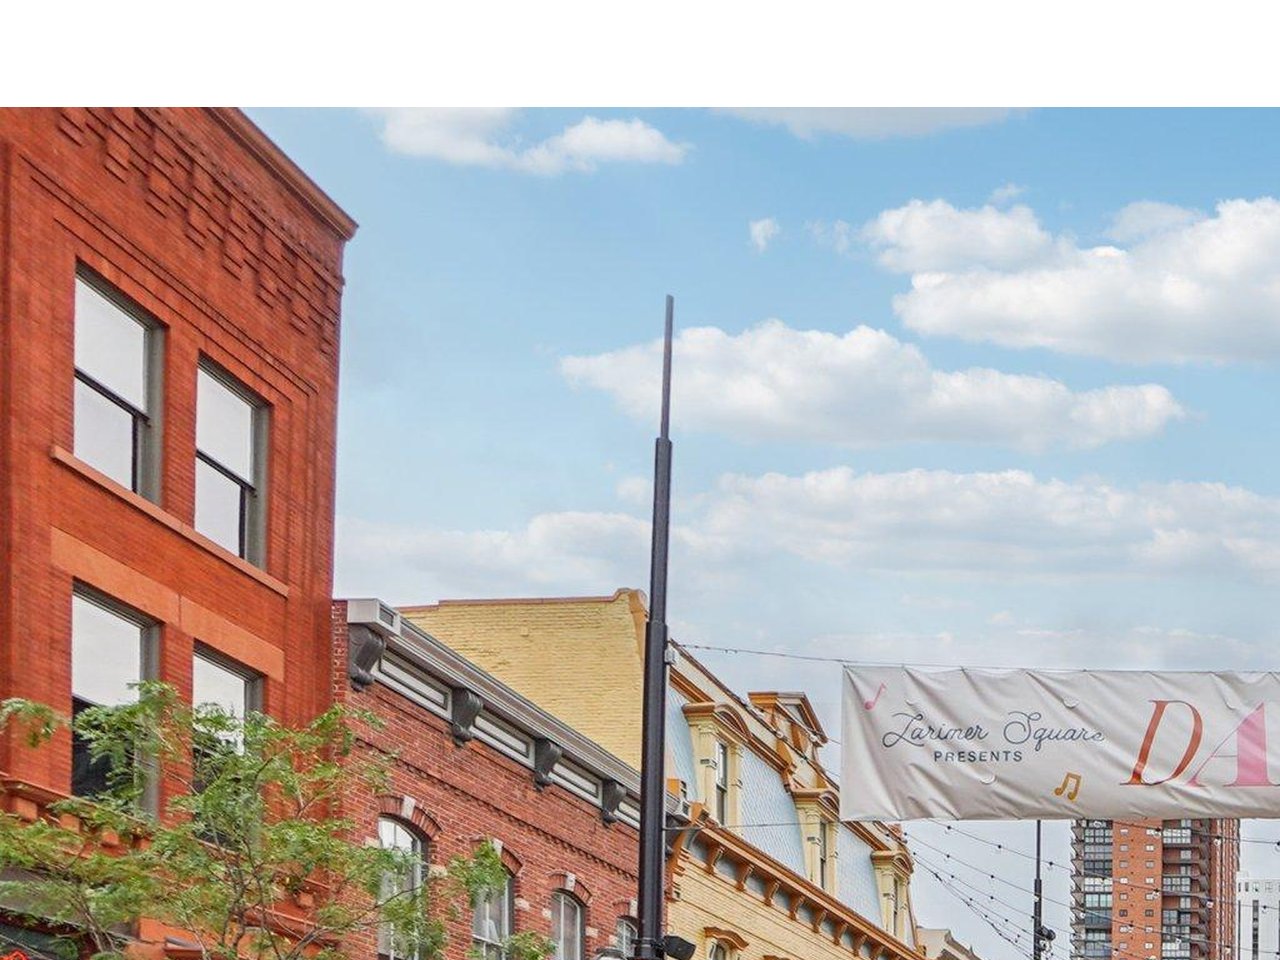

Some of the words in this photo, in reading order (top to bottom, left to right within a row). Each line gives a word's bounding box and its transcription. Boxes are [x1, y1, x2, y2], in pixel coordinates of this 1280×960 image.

[882, 712, 990, 748] Larimer
[1003, 711, 1105, 751] Square
[933, 751, 1022, 763] PRESENTS
